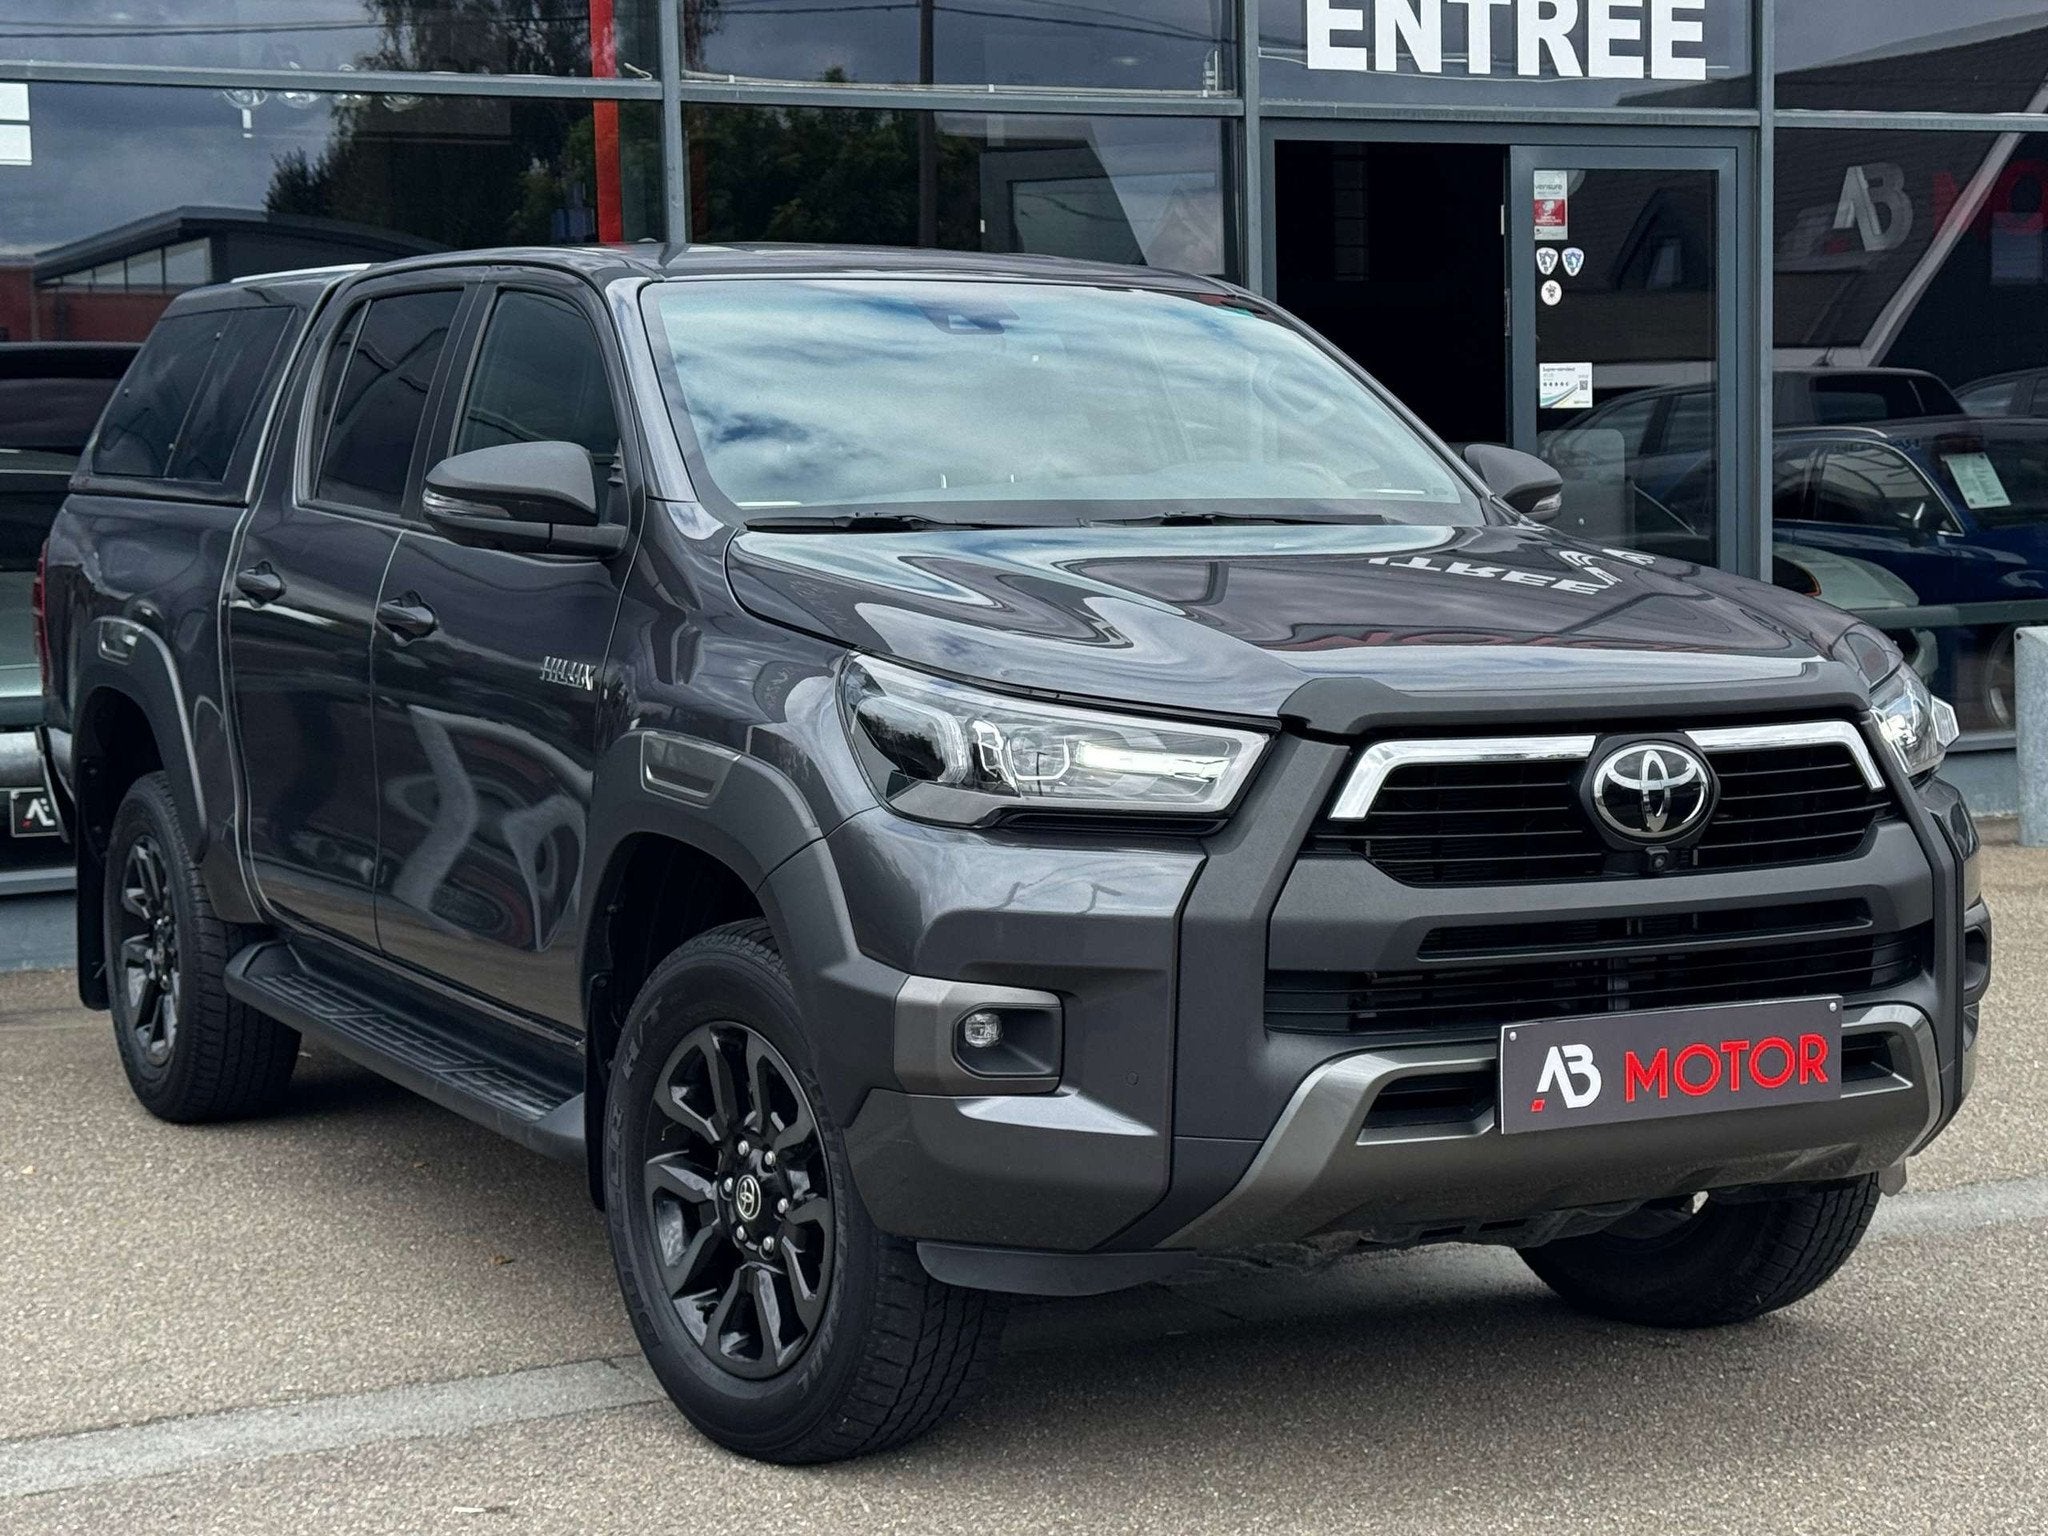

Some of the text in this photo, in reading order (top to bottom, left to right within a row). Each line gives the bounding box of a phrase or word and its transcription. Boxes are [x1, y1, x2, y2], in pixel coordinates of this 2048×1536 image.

[539, 655, 597, 691] HILUX
[1533, 1032, 1830, 1112] AB MOTOR
